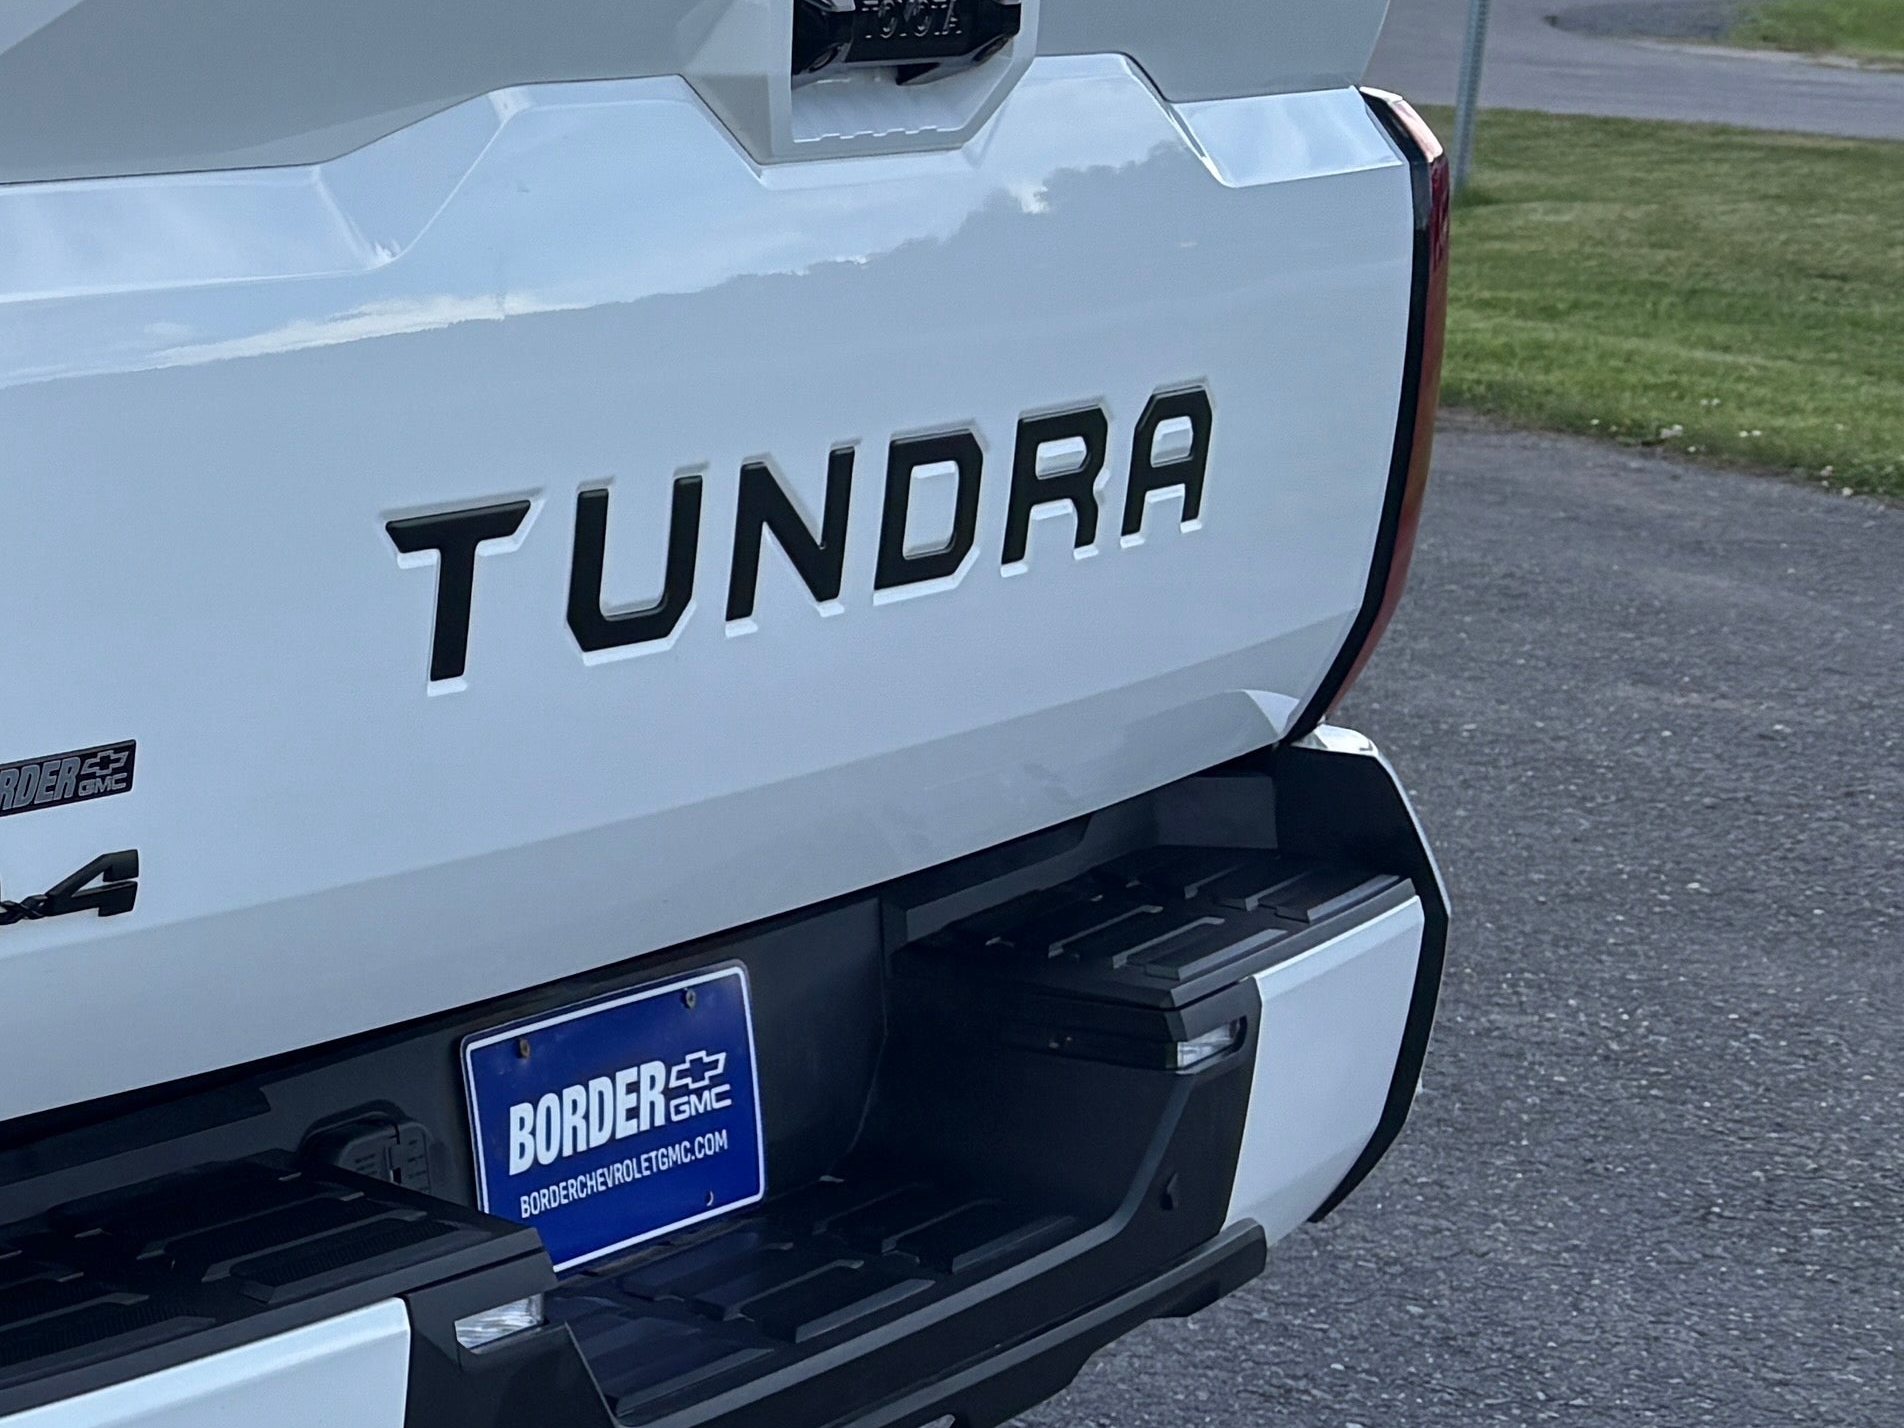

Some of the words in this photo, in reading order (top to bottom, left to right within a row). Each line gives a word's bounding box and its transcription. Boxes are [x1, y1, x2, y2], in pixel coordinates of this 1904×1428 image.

[385, 383, 1215, 684] TUNDRA
[78, 772, 128, 797] GMC
[509, 1060, 667, 1176] BORDER
[669, 1083, 733, 1123] GMC
[520, 1128, 729, 1219] BORDERCHEVROLETGMC.COM
